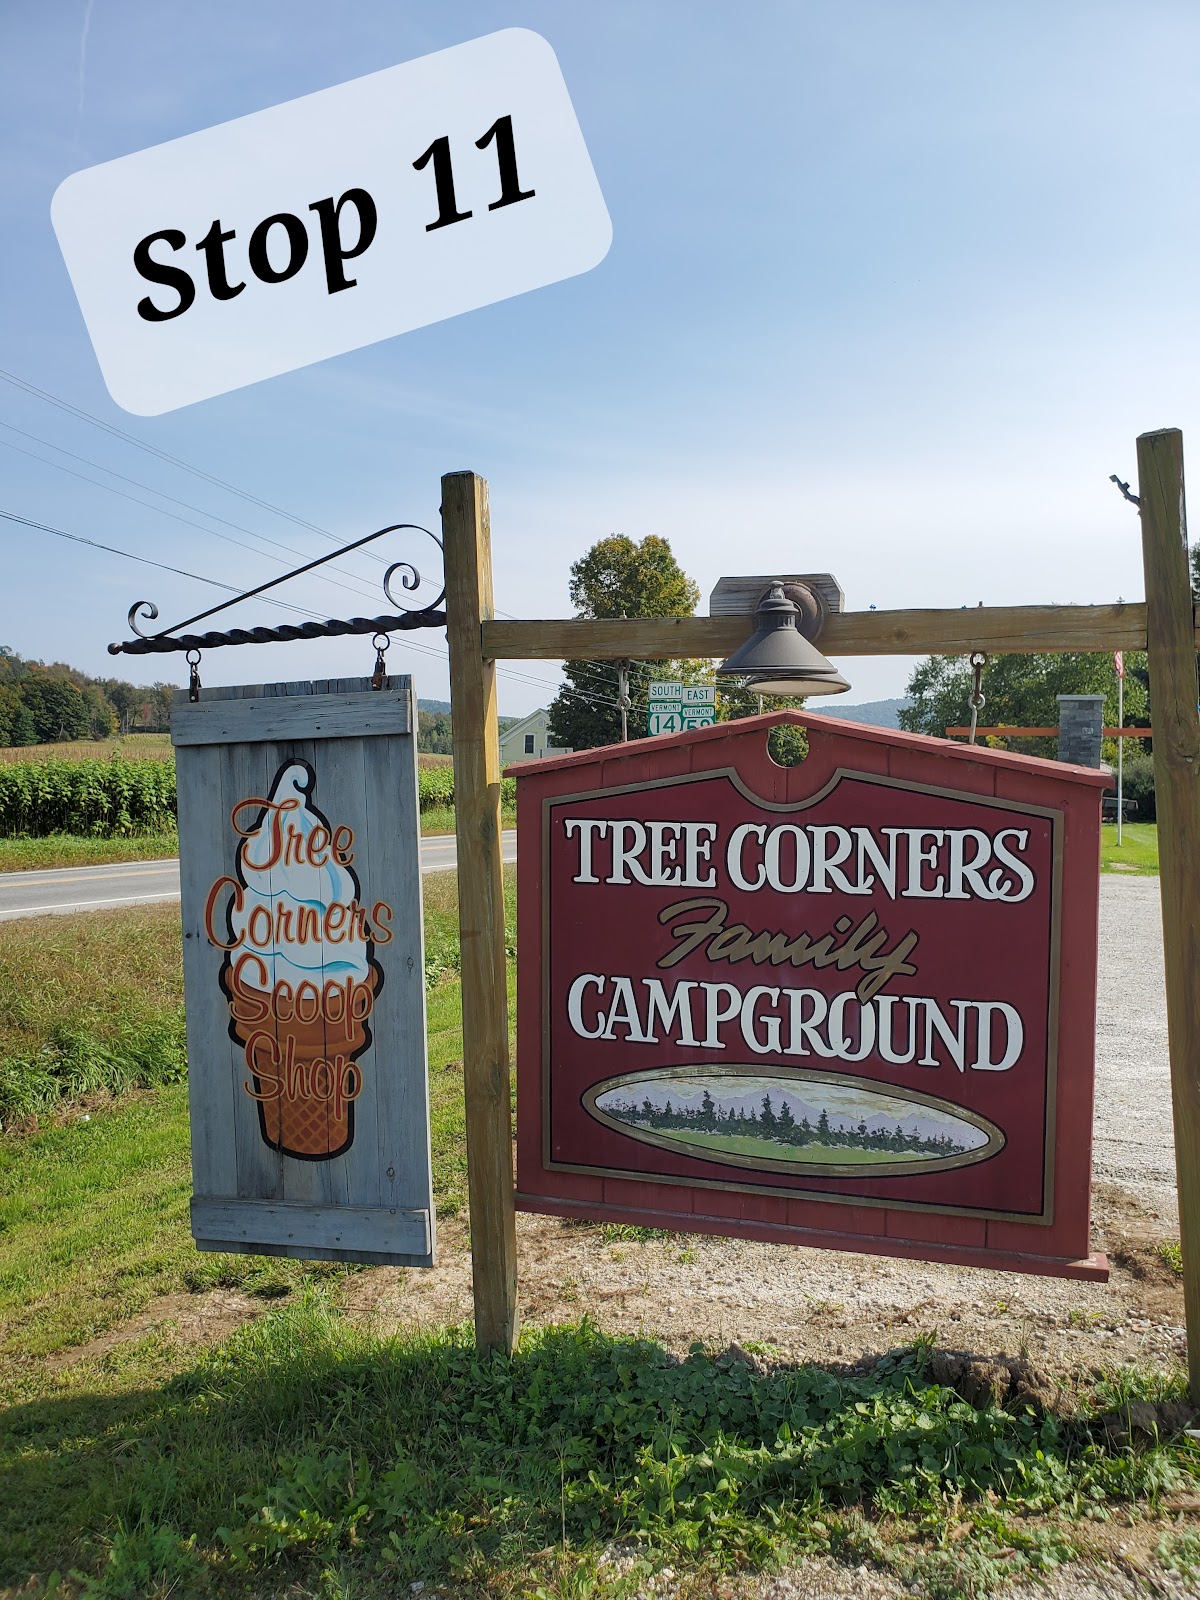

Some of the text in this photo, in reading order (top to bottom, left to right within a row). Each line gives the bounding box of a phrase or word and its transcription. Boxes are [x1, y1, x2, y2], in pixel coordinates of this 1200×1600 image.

[651, 685, 681, 696] SOUTH
[651, 702, 680, 712] VERMONT
[655, 715, 676, 734] 14
[684, 708, 712, 716] VERMONT
[687, 689, 709, 700] EAST
[230, 796, 356, 872] Tree
[565, 819, 1035, 903] TREE CORNERS
[204, 874, 394, 952] Corners
[657, 898, 920, 1005] Family
[228, 952, 374, 1043] Scoop
[567, 974, 1025, 1073] CAMPGROUND
[243, 1029, 363, 1121] Shop
